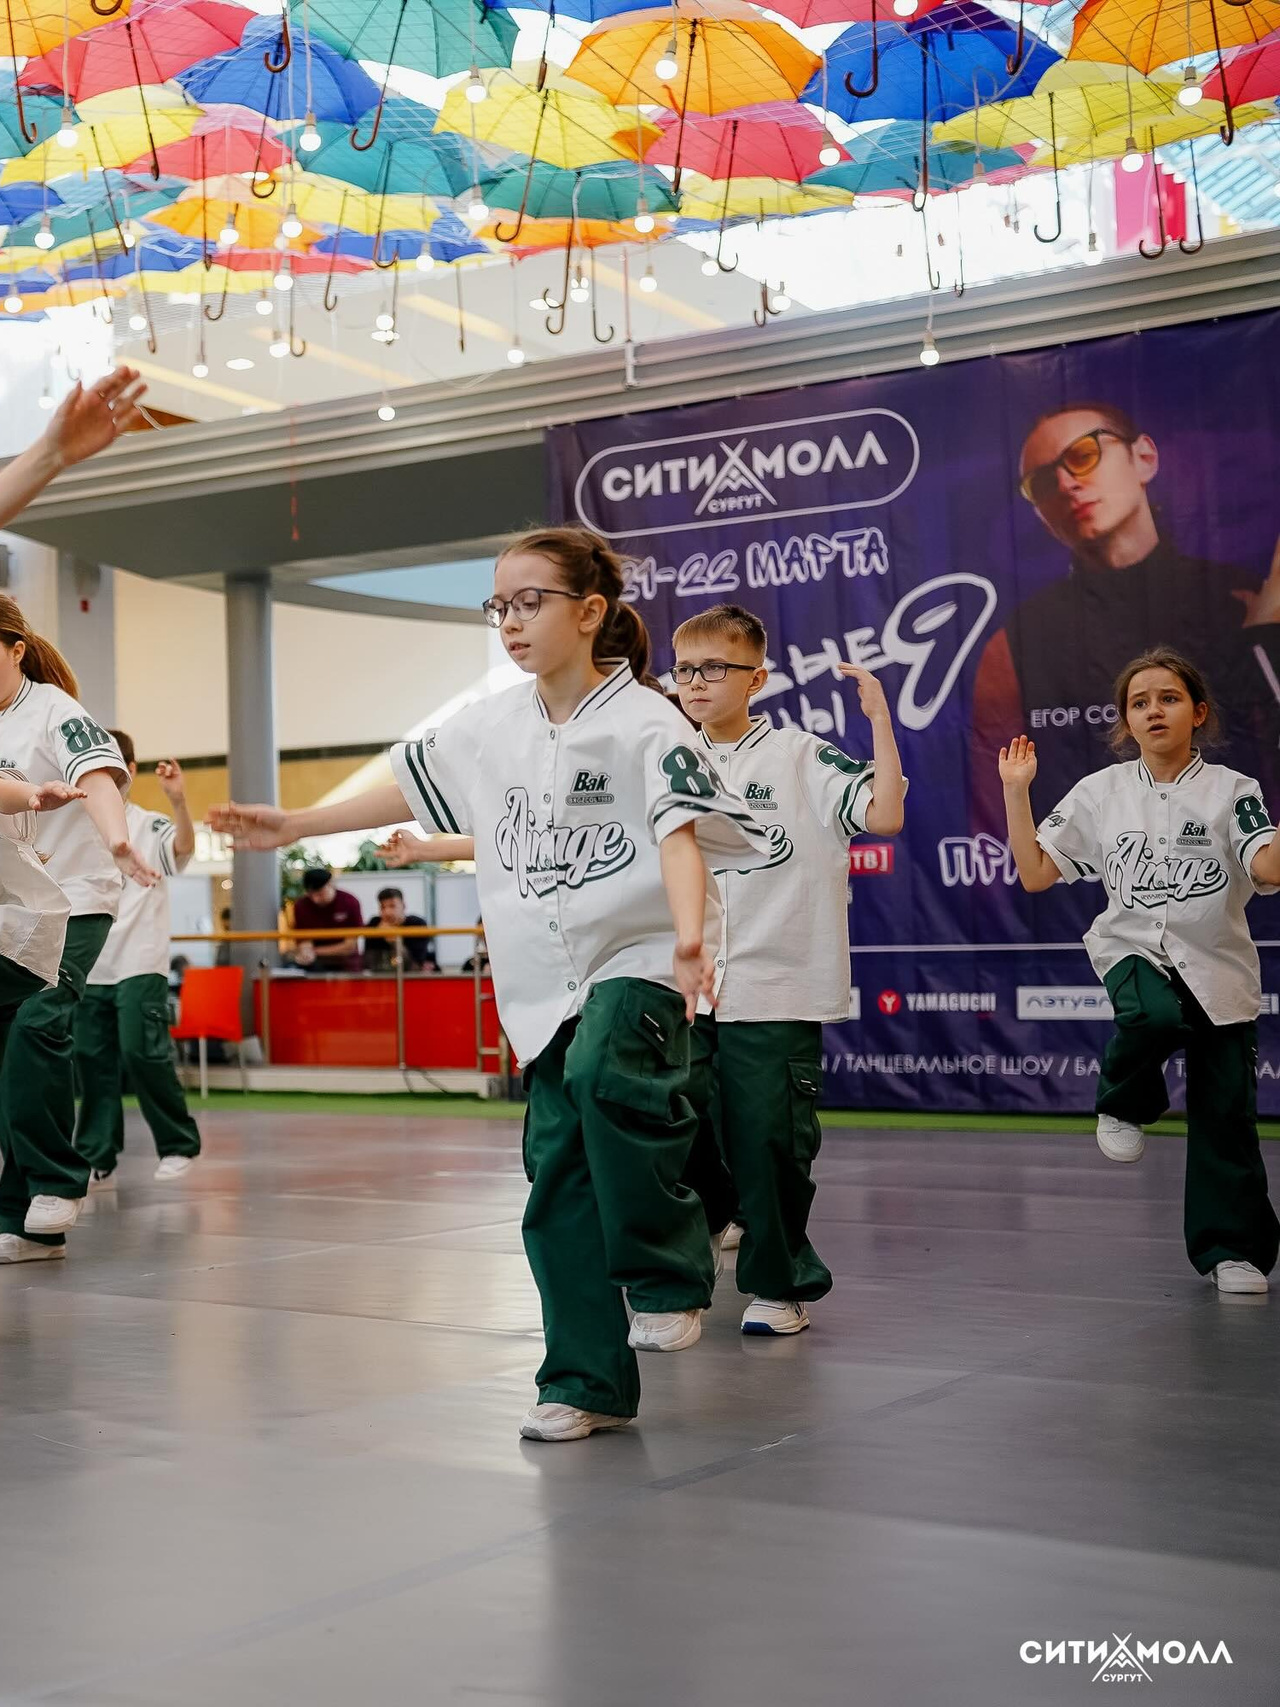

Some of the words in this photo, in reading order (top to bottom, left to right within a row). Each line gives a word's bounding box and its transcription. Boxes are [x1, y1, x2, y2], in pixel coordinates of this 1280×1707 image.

[707, 493, 764, 514] СУРГУТ
[746, 526, 889, 589] МАРТА
[1030, 706, 1081, 729] ЕГОР
[572, 770, 610, 792] Bak
[744, 782, 774, 800] Bak
[1181, 820, 1208, 837] Bak
[905, 992, 997, 1012] YAMAGUCHI
[845, 1053, 997, 1076] ТАНЦЕВАЛЬНОЕ
[1000, 1055, 1054, 1077] ШОУ
